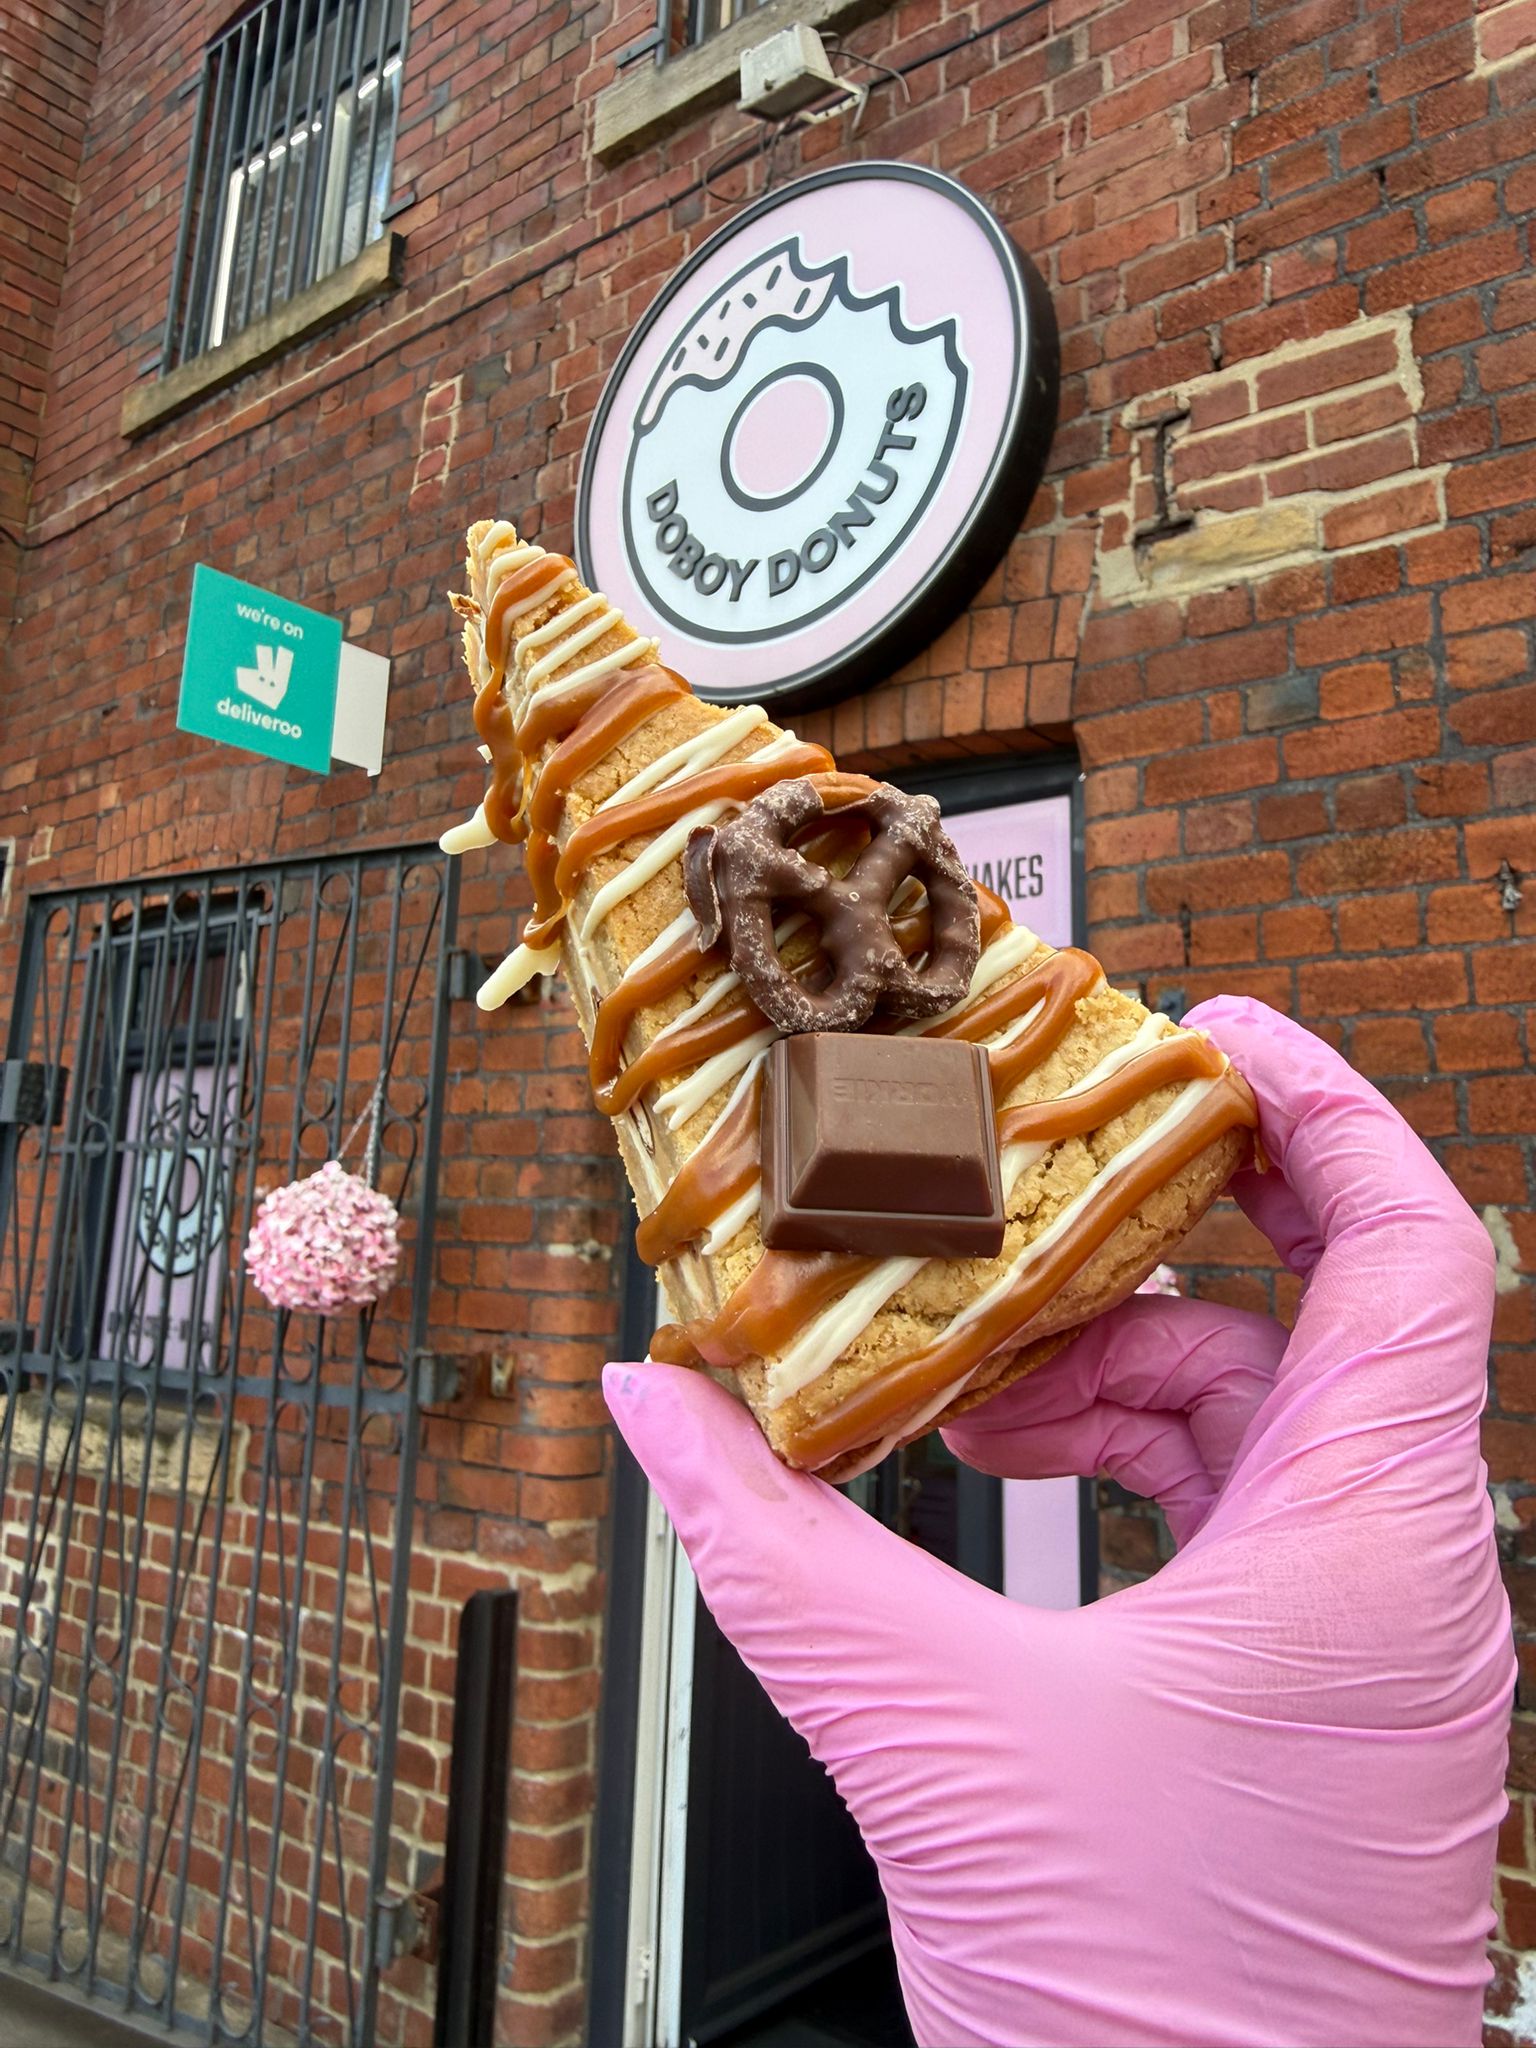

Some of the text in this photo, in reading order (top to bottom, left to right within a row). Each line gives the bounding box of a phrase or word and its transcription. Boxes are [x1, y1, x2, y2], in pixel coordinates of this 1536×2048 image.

[646, 381, 927, 602] DOBOY DONUTS
[236, 603, 304, 640] we're on
[216, 697, 302, 739] deliveroo
